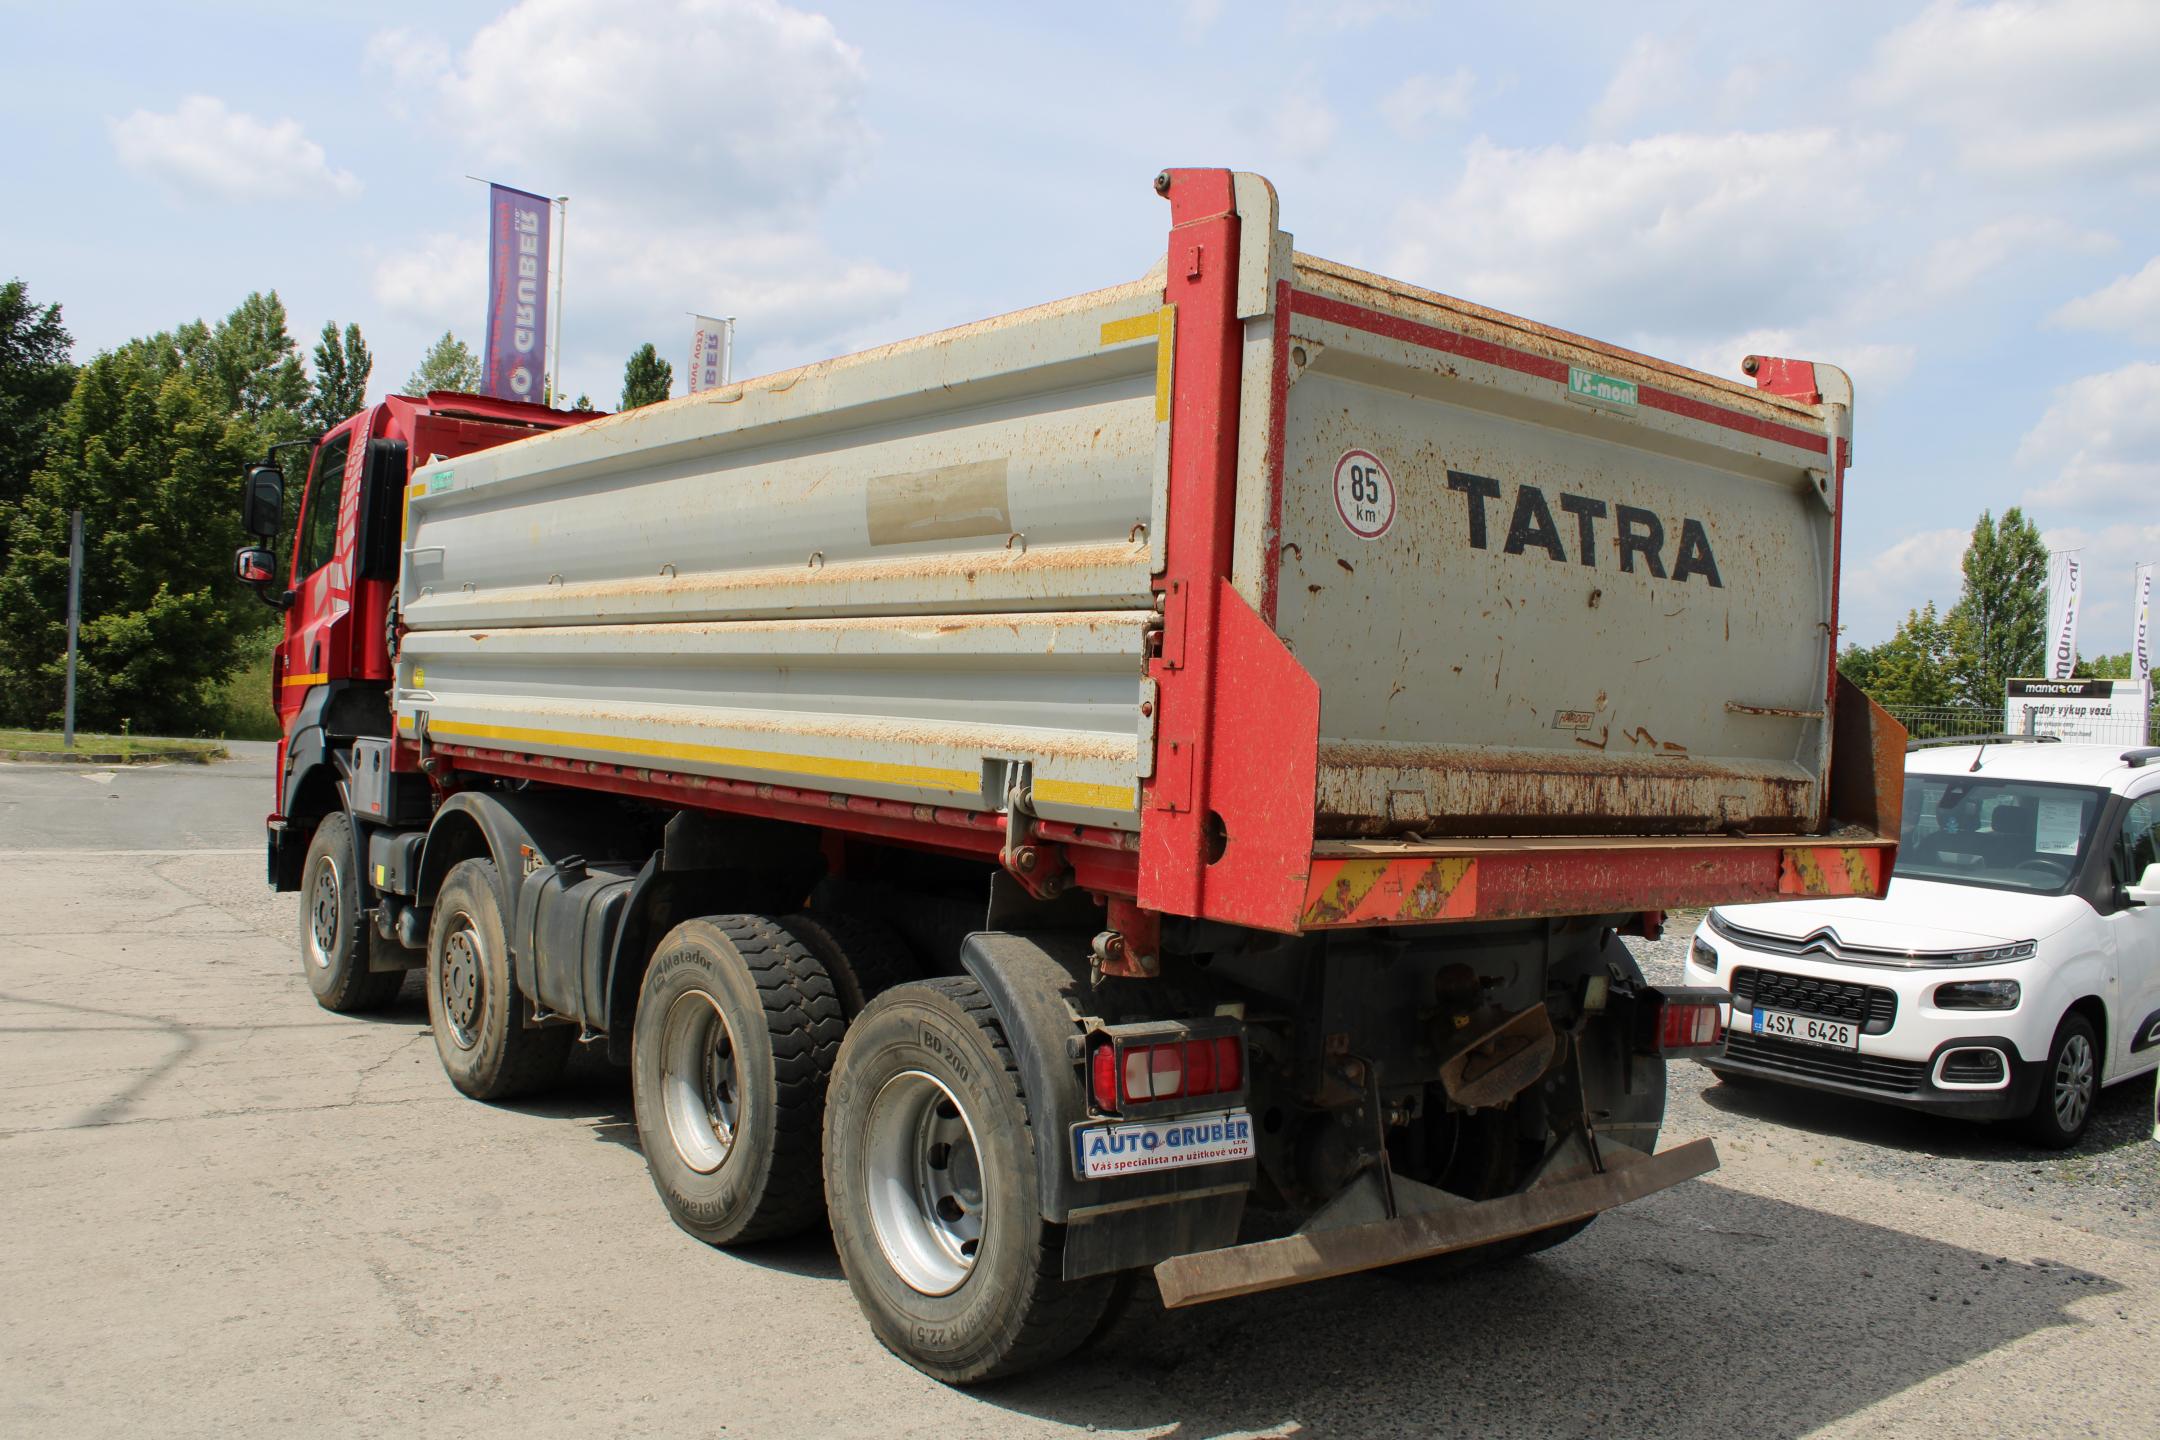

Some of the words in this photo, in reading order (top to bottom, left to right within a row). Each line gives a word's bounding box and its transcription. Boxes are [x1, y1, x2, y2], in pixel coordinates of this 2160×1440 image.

[1350, 464, 1379, 505] 85
[1356, 504, 1376, 523] km
[1446, 469, 1723, 588] TATRA
[2025, 684, 2059, 693] mama
[2066, 684, 2085, 694] car
[2058, 703, 2087, 717] výkup
[662, 950, 713, 972] Matador
[1766, 1014, 1795, 1035] 4SX
[1808, 1021, 1849, 1043] 6426
[945, 1047, 969, 1082] 200
[1089, 1130, 1159, 1157] AUTO
[1165, 1120, 1249, 1148] GRUBER
[1114, 1155, 1169, 1171] specialista
[1172, 1154, 1184, 1163] na
[1186, 1147, 1226, 1161] užitkové
[1228, 1146, 1248, 1156] vozy
[917, 1326, 946, 1345] 22.5
